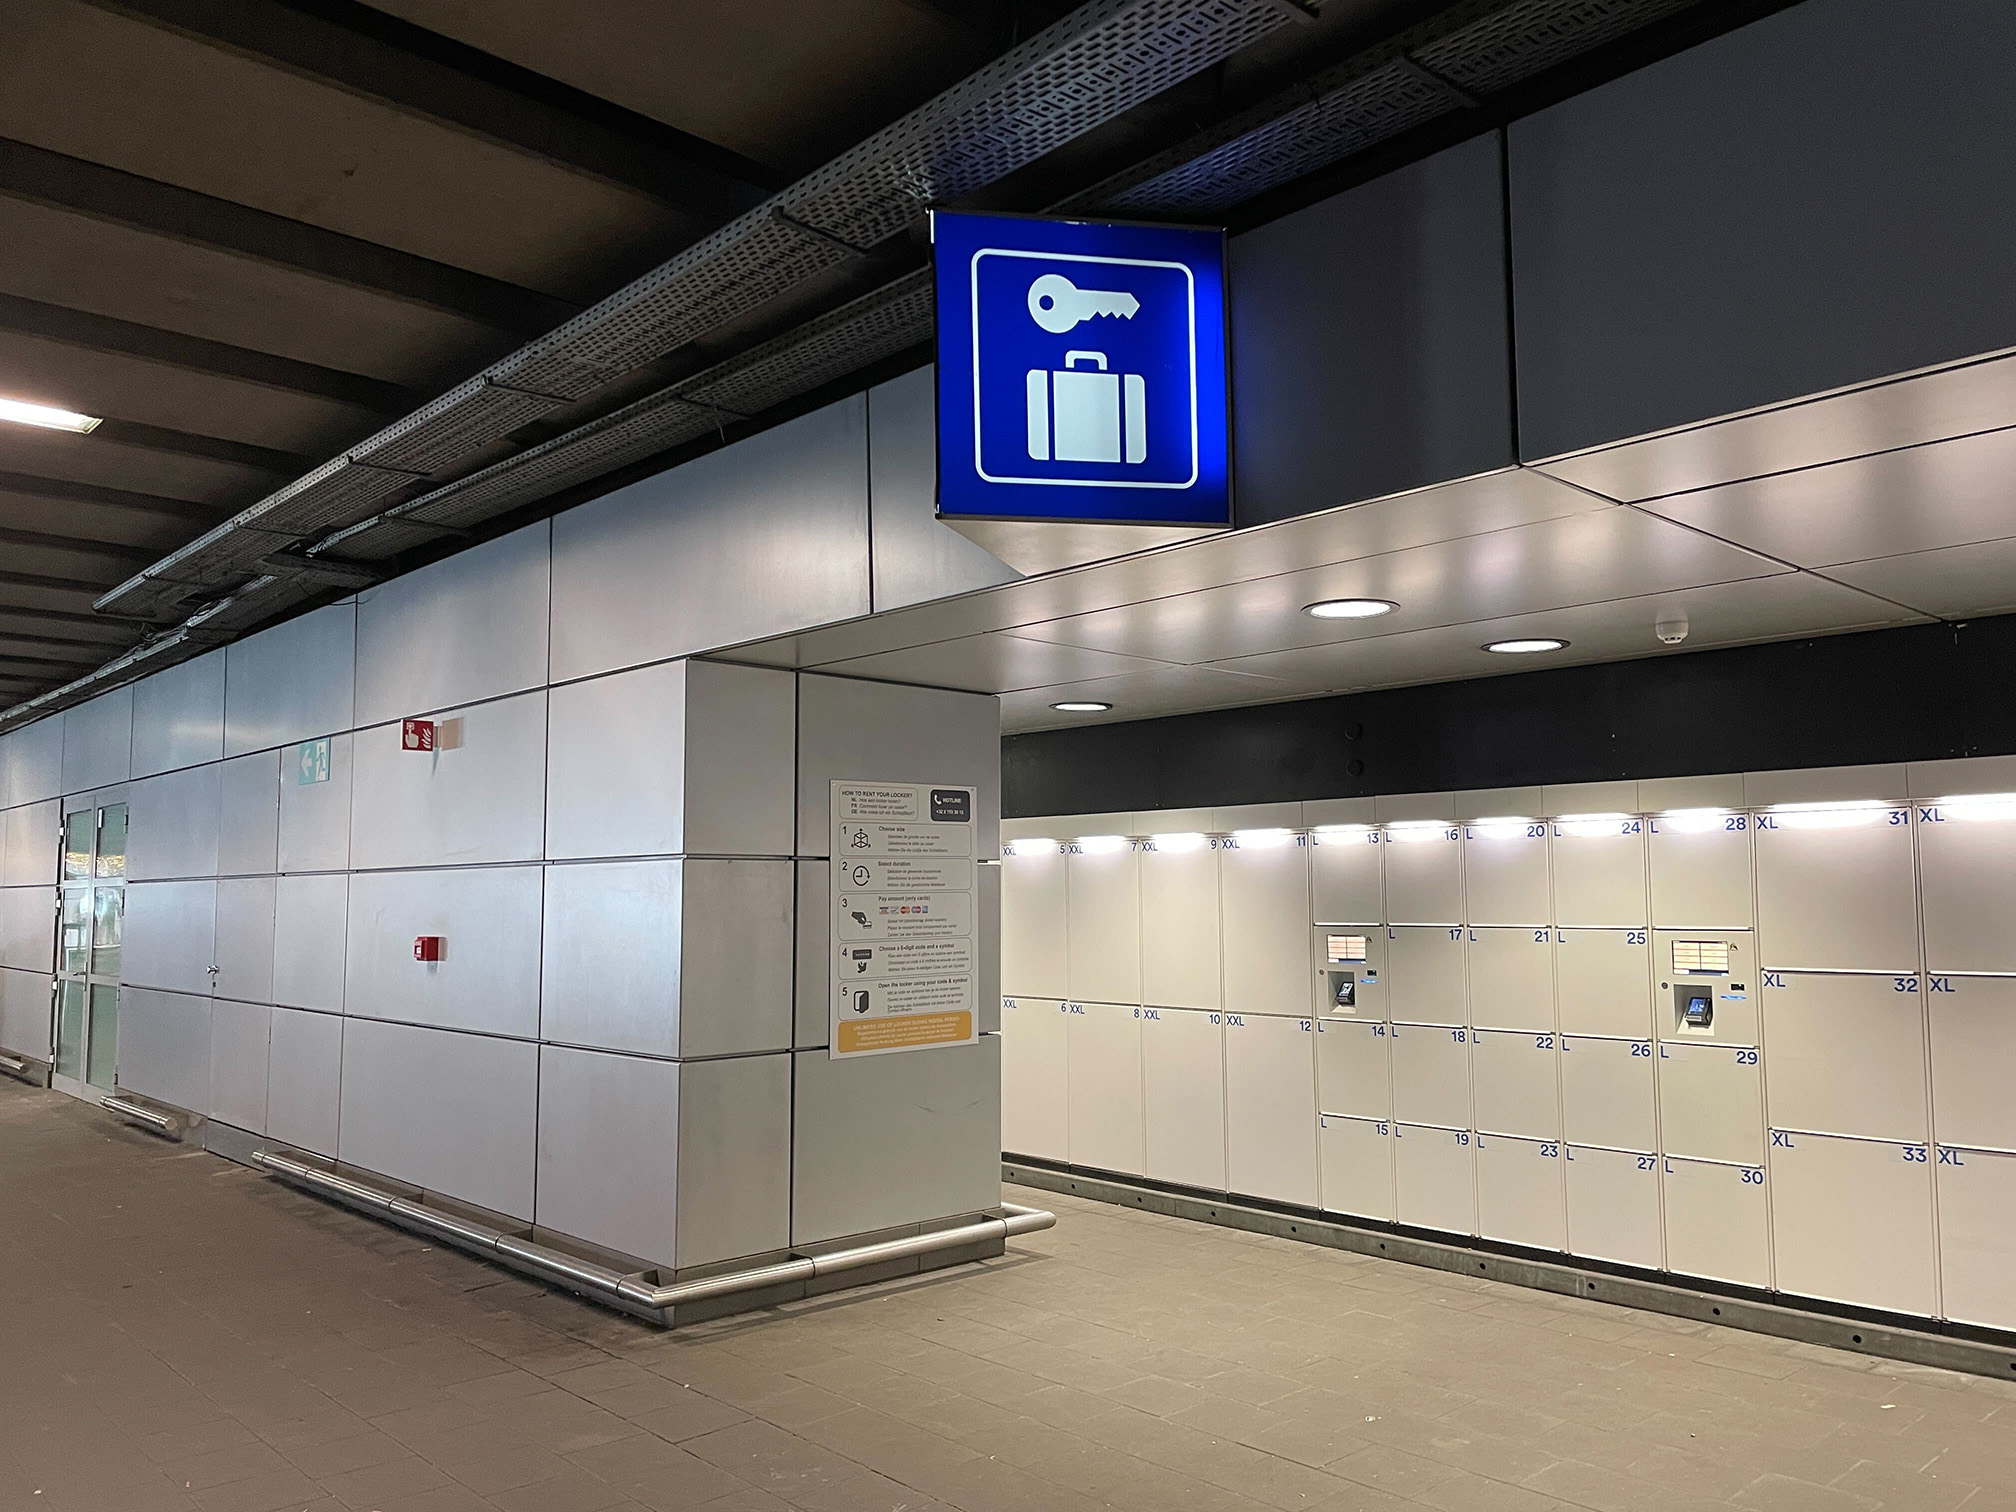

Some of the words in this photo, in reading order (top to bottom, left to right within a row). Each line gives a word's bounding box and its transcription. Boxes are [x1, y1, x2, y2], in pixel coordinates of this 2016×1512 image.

[1757, 816, 1778, 830] XL
[1889, 811, 1908, 825] 31
[1920, 808, 1945, 822] XL
[843, 826, 846, 834] 1
[1466, 828, 1473, 840] L
[1527, 825, 1545, 837] 20
[1554, 825, 1562, 837] L
[1622, 822, 1641, 835] 24
[1651, 822, 1659, 834] L
[1726, 817, 1747, 831] 28
[1222, 839, 1240, 849] XXL
[1296, 836, 1306, 847] 11
[1313, 835, 1319, 845] L
[1367, 833, 1379, 844] 13
[1386, 832, 1392, 843] L
[1445, 829, 1458, 841] 16
[1002, 847, 1016, 856] XXL
[1060, 845, 1065, 854] 5
[1068, 845, 1083, 854] XXL
[1131, 842, 1137, 852] 7
[1142, 842, 1158, 851] XXL
[1210, 840, 1217, 849] 9
[842, 862, 847, 870] 2
[842, 899, 848, 907] 3
[1389, 929, 1395, 939] L
[1449, 930, 1462, 941] 17
[1470, 930, 1477, 941] L
[1535, 931, 1549, 943] 21
[1558, 931, 1565, 943] L
[1627, 933, 1646, 945] 25
[842, 948, 847, 957] 4
[1763, 974, 1786, 988] XL
[1894, 978, 1918, 993] 32
[1930, 978, 1955, 992] XL
[842, 987, 848, 996] 5
[1003, 999, 1017, 1008] XXL
[1061, 1003, 1067, 1012] 6
[1070, 1005, 1085, 1014] XXL
[1134, 1009, 1140, 1018] 8
[1144, 1010, 1160, 1020] XXL
[1209, 1014, 1220, 1024] 10
[1226, 1015, 1244, 1026] XXL
[1300, 1021, 1311, 1032] 12
[1318, 1022, 1324, 1032] L
[1372, 1026, 1386, 1037] 14
[1392, 1026, 1398, 1037] L
[1452, 1031, 1466, 1043] 18
[1473, 1032, 1480, 1044] L
[1536, 1037, 1554, 1049] 22
[1563, 1039, 1570, 1051] L
[1631, 1044, 1651, 1057] 26
[1660, 1046, 1669, 1058] L
[1736, 1051, 1758, 1065] 29
[1321, 1118, 1327, 1128] L
[1376, 1124, 1389, 1135] 15
[1395, 1127, 1402, 1138] L
[1455, 1133, 1469, 1145] 19
[1478, 1136, 1485, 1148] L
[1541, 1144, 1558, 1157] 23
[1772, 1133, 1794, 1148] XL
[1902, 1147, 1927, 1162] 33
[1567, 1148, 1574, 1161] L
[1638, 1157, 1656, 1170] 27
[1938, 1150, 1964, 1166] XL
[1665, 1160, 1674, 1173] L
[1741, 1170, 1764, 1184] 30
